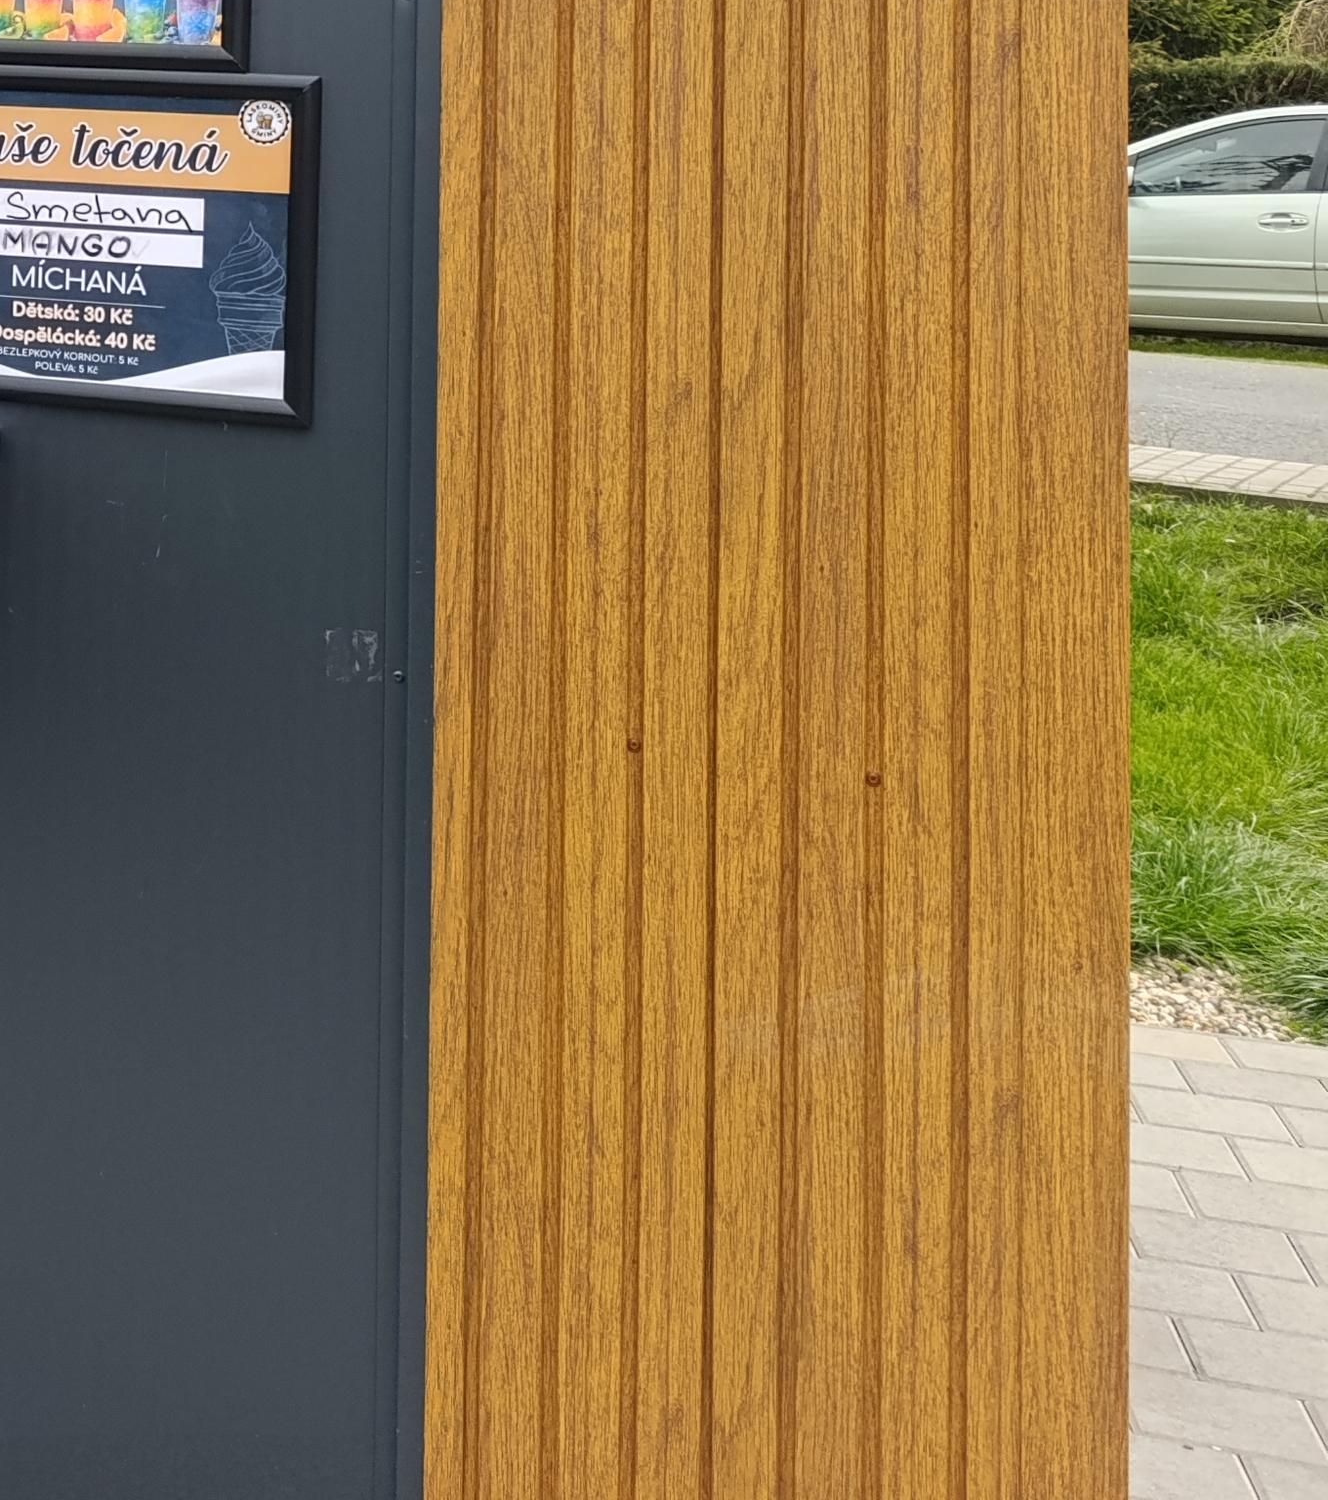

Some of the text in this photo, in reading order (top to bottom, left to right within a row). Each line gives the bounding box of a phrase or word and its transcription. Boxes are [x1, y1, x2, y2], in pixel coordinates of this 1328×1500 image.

[71, 123, 229, 174] točená
[5, 191, 194, 231] Smetana
[2, 231, 131, 258] MANGO
[11, 259, 147, 296] MÍCHANÁ
[12, 301, 133, 325] Dětská: 30 Kč
[104, 332, 128, 349] 40
[133, 333, 156, 351] Kč
[35, 361, 98, 374] POLEVA: 5 Kč
[63, 352, 117, 365] KORNOUT:
[119, 356, 125, 364] 5
[127, 356, 139, 365] Kč
